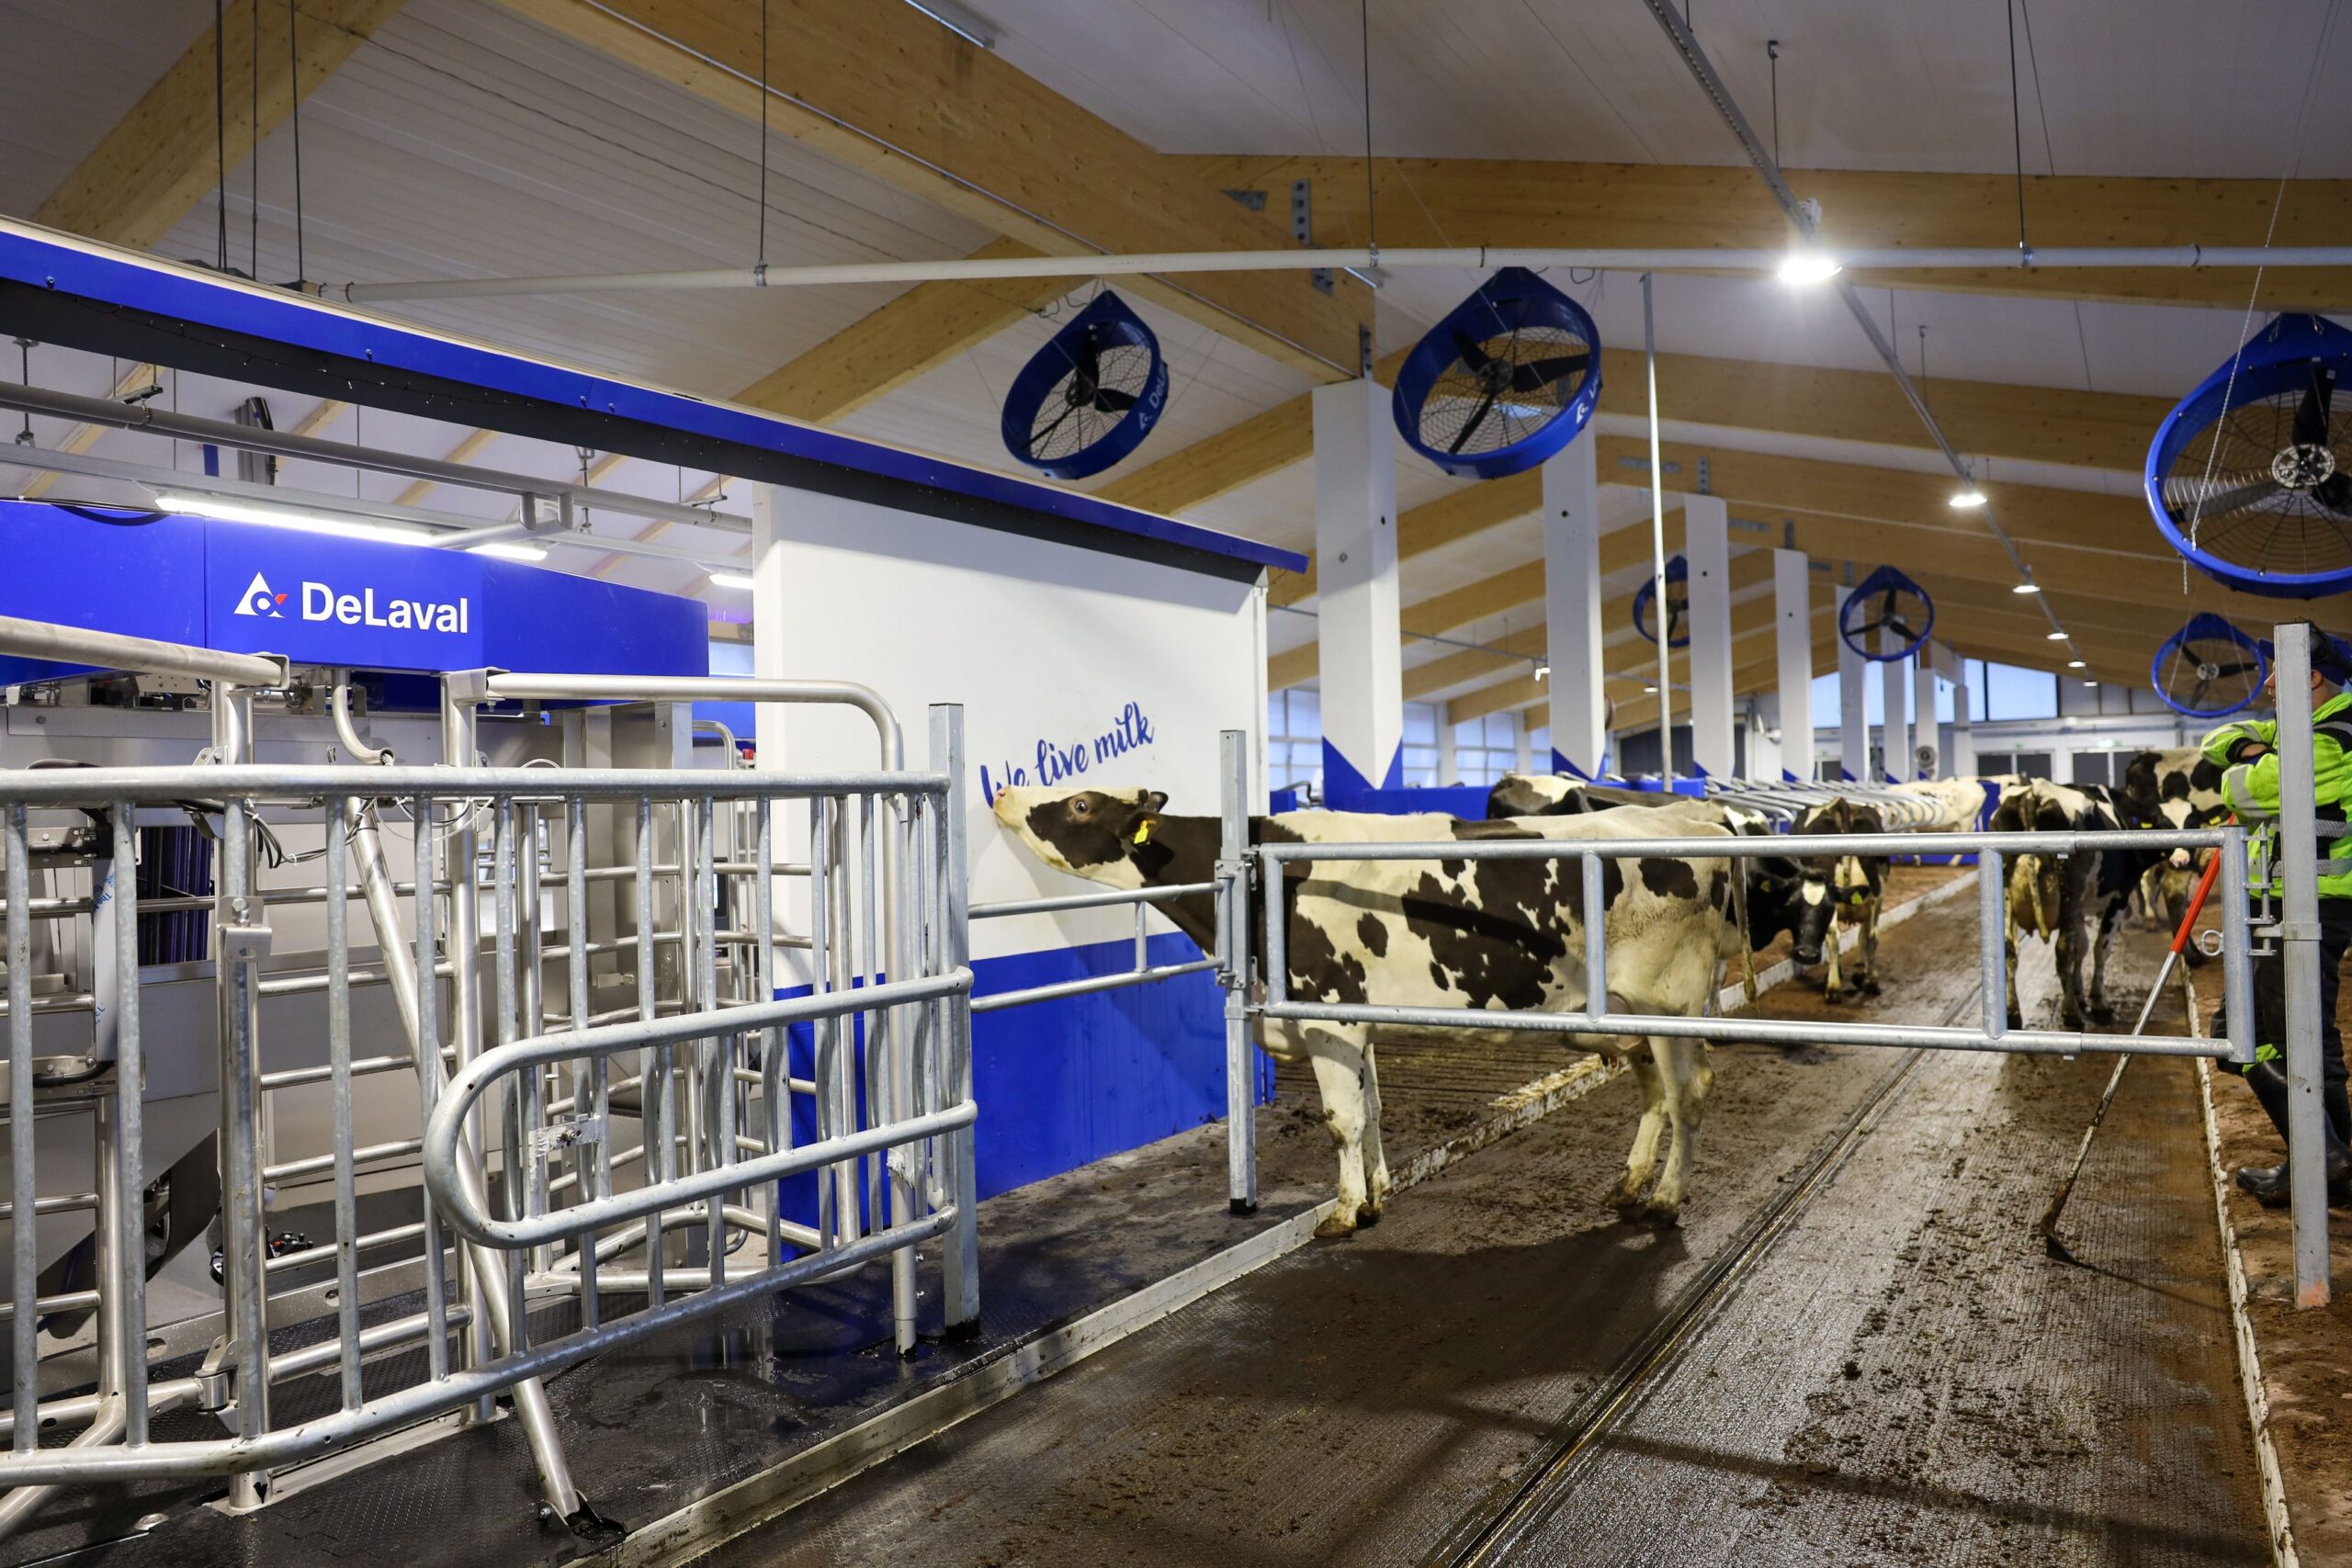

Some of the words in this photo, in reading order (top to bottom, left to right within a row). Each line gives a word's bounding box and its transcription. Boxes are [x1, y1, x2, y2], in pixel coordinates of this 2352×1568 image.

[301, 581, 469, 634] DeLaval
[1034, 739, 1090, 787] live
[1093, 701, 1155, 764] milk
